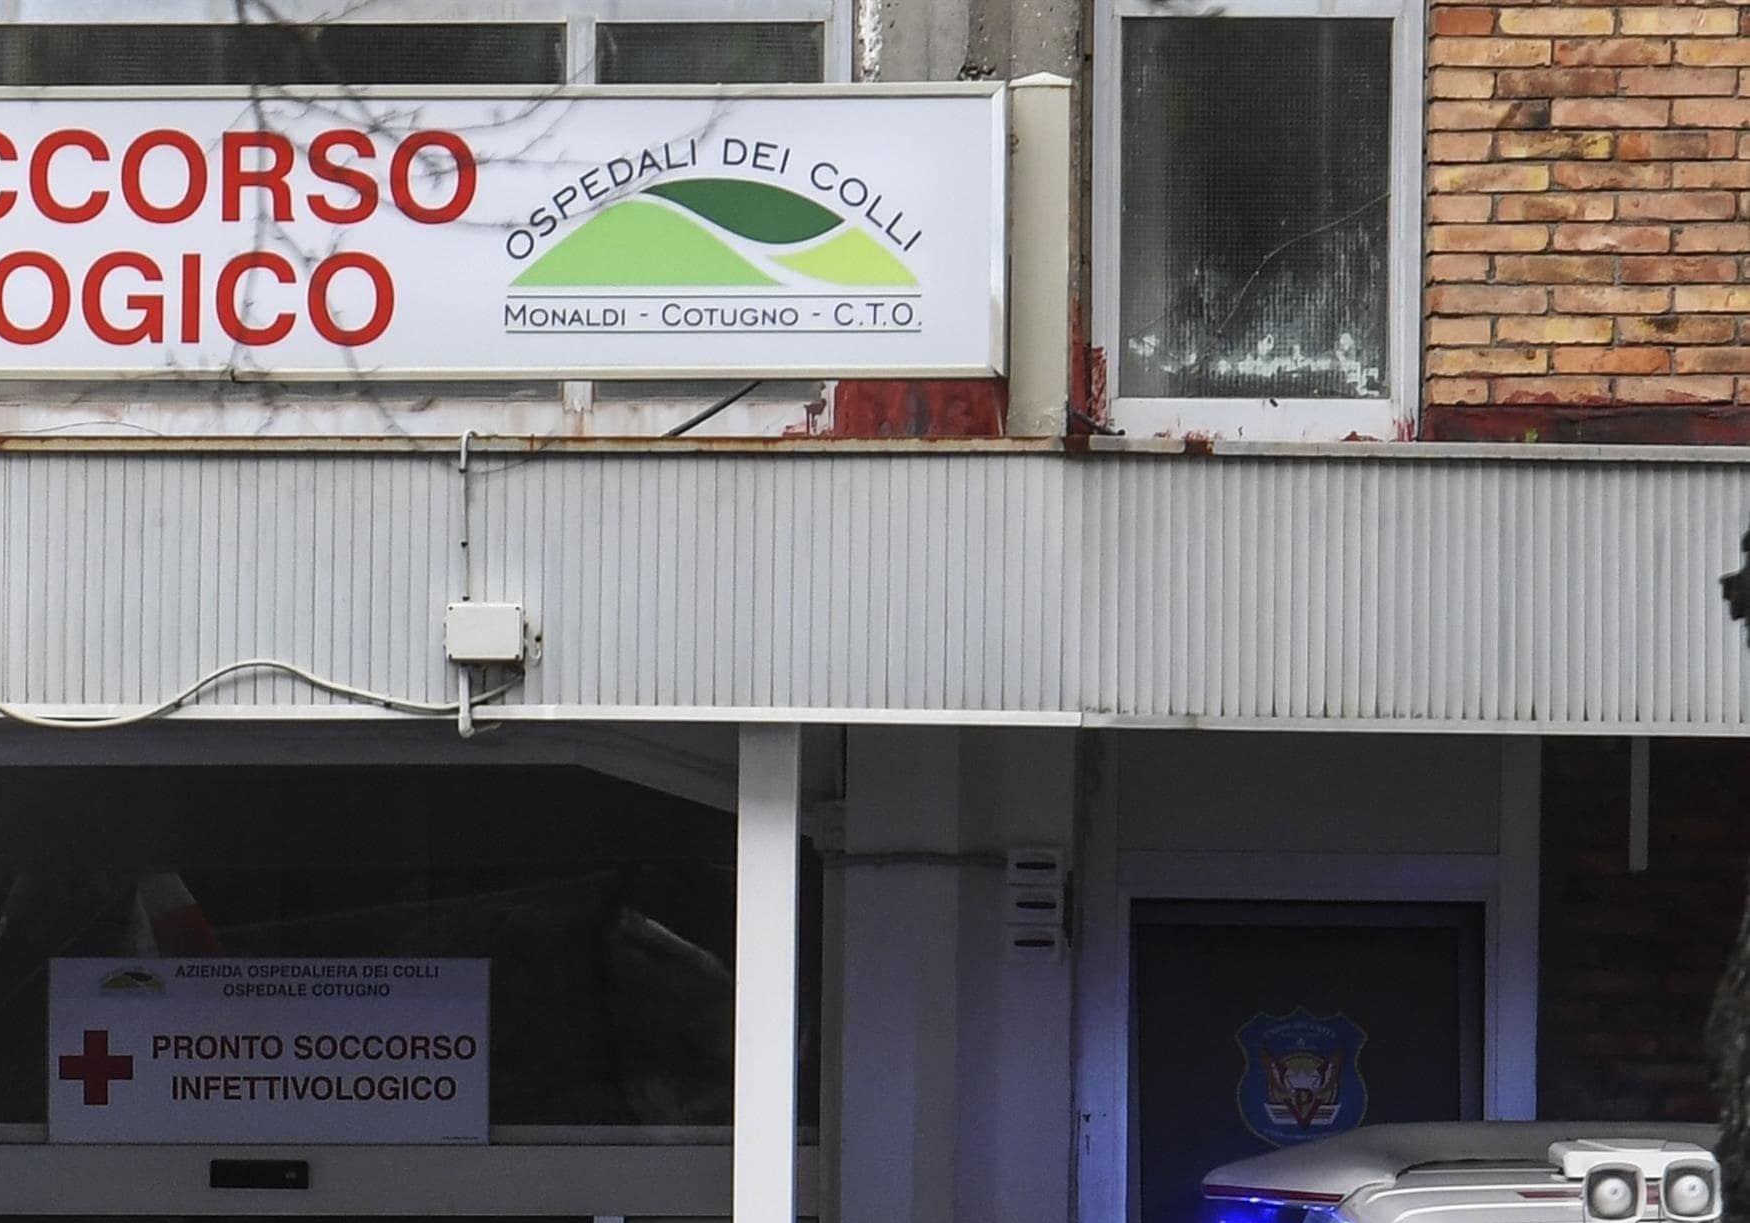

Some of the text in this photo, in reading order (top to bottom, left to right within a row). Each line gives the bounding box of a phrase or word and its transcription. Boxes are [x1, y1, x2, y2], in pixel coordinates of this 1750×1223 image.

[506, 137, 923, 260] OSPEDALI DEI COLLI
[834, 302, 923, 327] C.T.O.
[175, 964, 439, 979] AZIENDA OSPEDALIERA DEI COLLI
[222, 983, 390, 998] OSPEDALE COTUGNO
[152, 1035, 477, 1061] PRONTO SOCCORSO
[171, 1075, 457, 1101] INFETTIVOLOGICO
